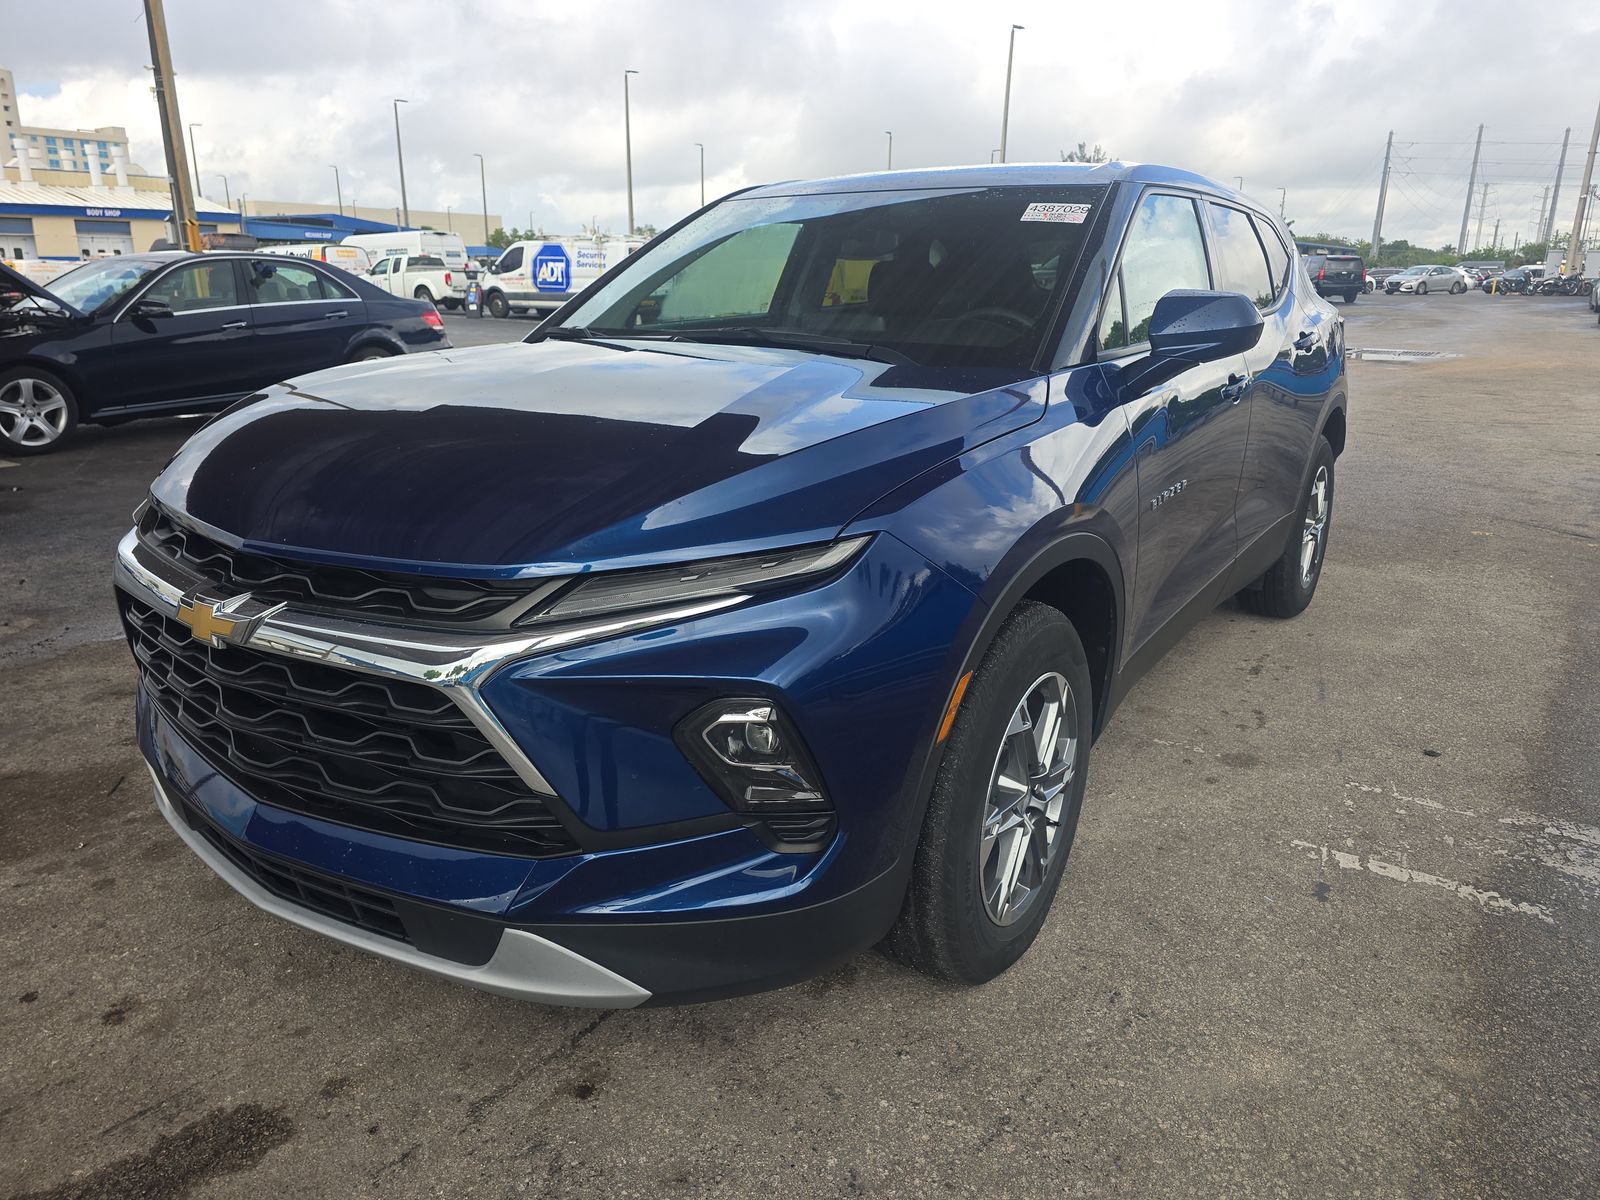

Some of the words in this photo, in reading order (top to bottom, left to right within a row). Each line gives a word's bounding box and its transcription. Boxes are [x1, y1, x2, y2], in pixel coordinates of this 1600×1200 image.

[86, 208, 103, 217] BODY
[104, 208, 121, 217] SHOP
[1029, 204, 1090, 214] 4387029
[576, 250, 607, 261] Security
[576, 260, 607, 269] Services
[538, 261, 566, 283] ADT
[1150, 479, 1188, 511] BLAZER
